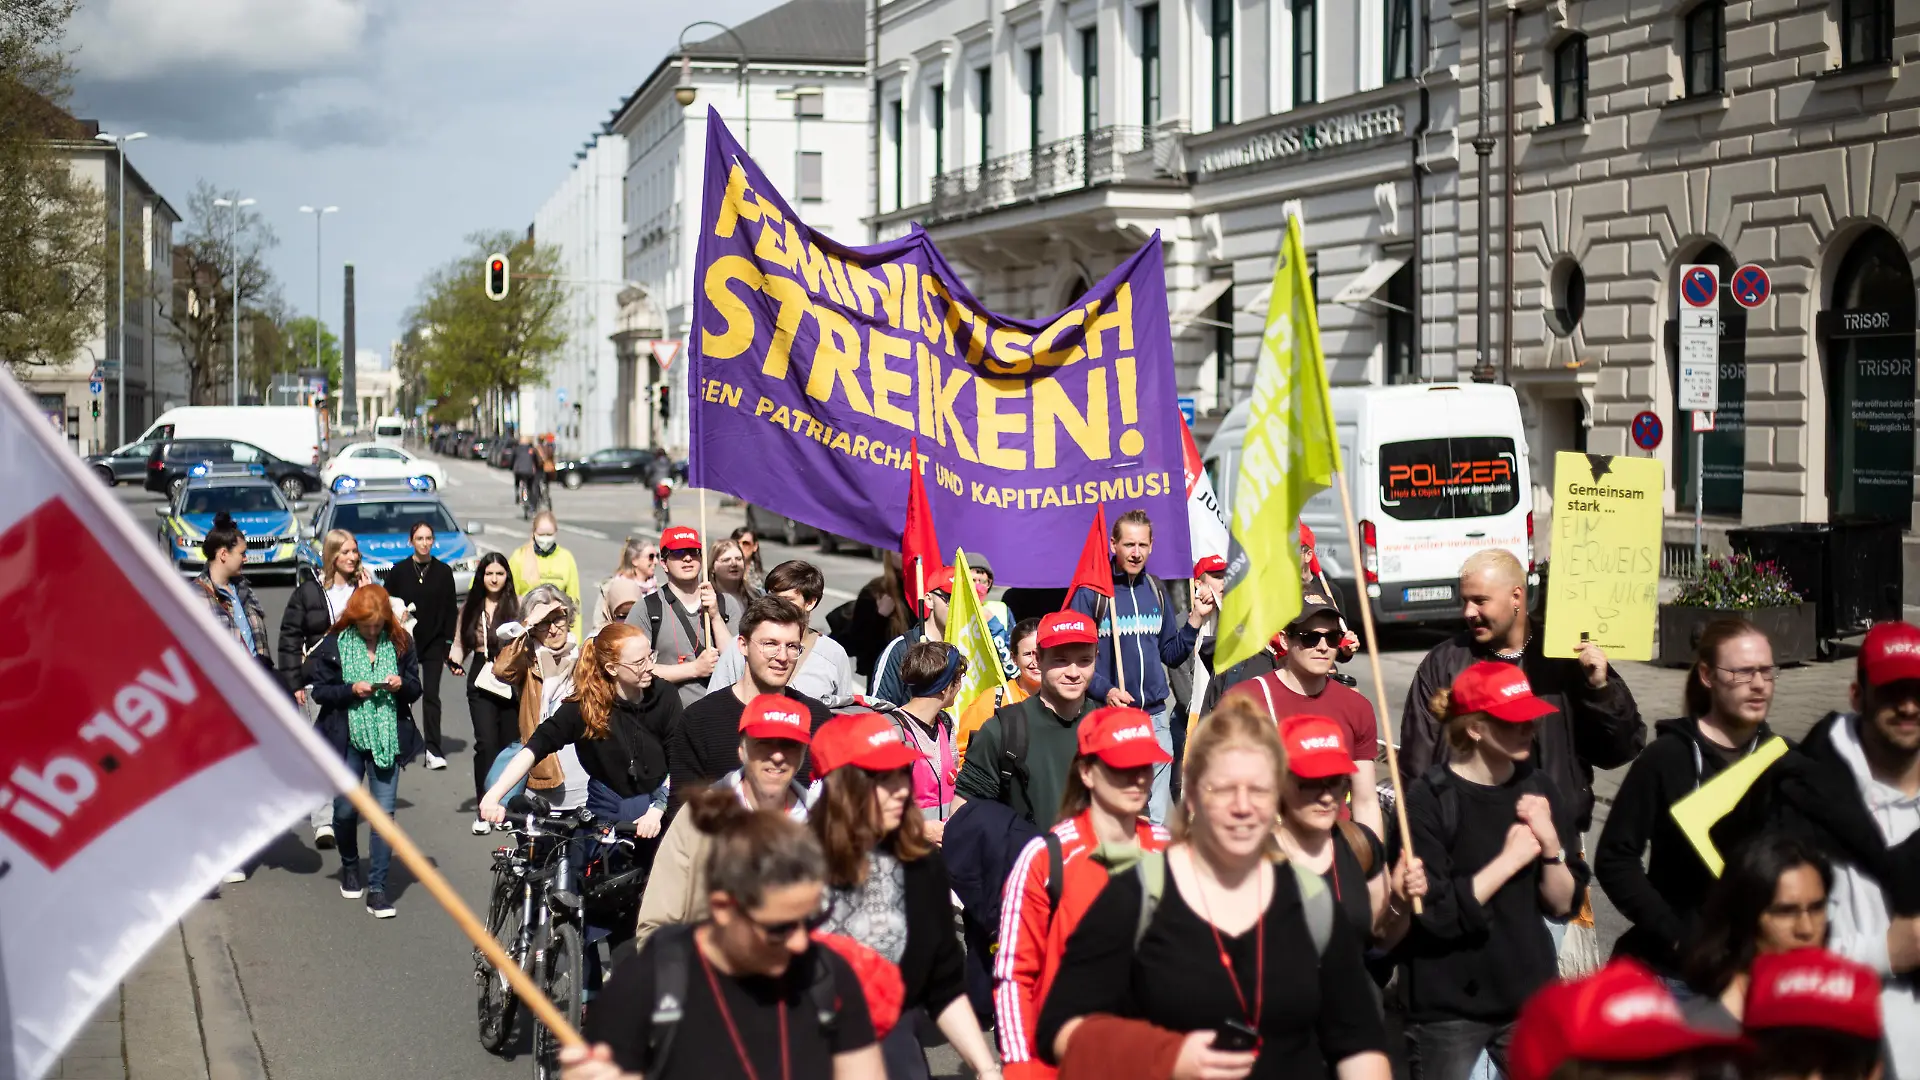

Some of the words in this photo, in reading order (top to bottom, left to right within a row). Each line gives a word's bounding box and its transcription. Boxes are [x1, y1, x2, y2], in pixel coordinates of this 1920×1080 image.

[714, 164, 1134, 374] FEMINISTISCH
[701, 255, 1145, 471] STREIKEN!
[701, 377, 744, 408] EN
[755, 396, 930, 475] PATRIARCHAT
[935, 462, 964, 496] UND
[970, 472, 1172, 509] KAPITALISMUS!
[1388, 460, 1511, 488] POLZER
[1568, 483, 1645, 500] Gemeinsam
[1567, 500, 1601, 513] stark
[1052, 621, 1085, 632] ver.di
[763, 711, 800, 726] ver.di
[1300, 735, 1340, 750] ver.di
[1777, 973, 1855, 1000] ver.di
